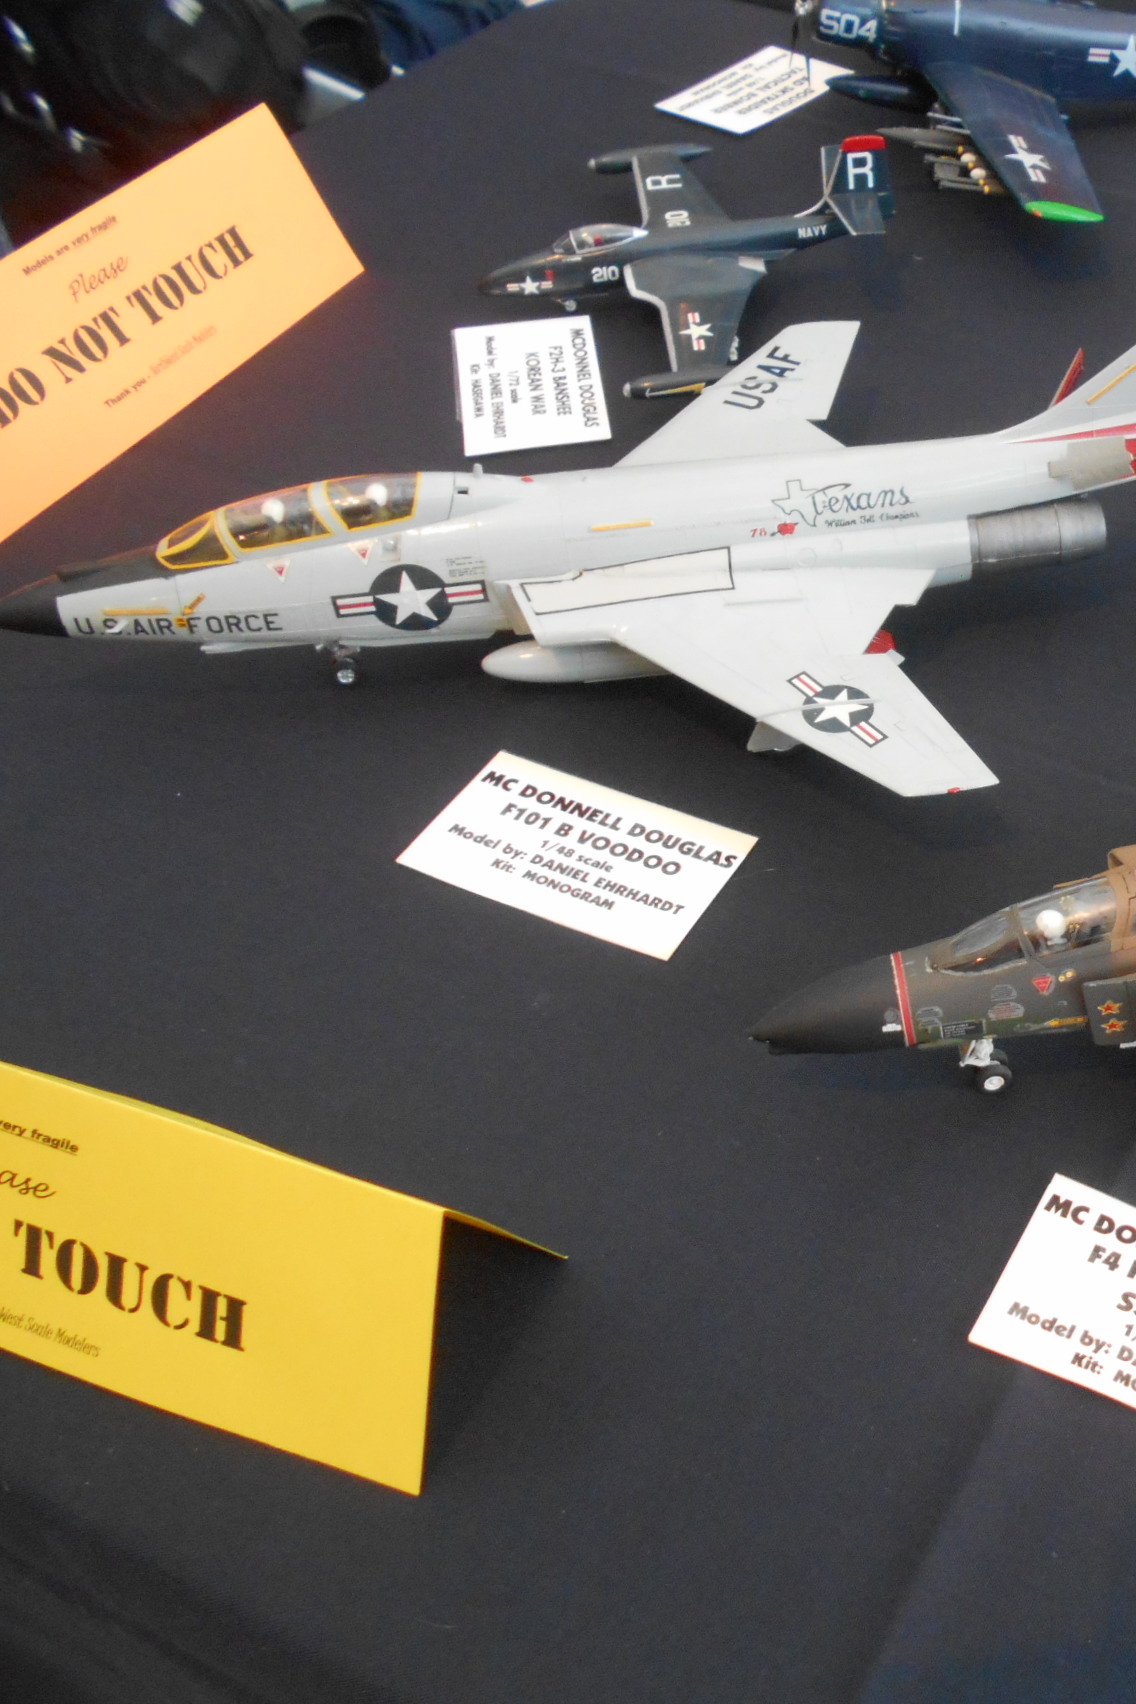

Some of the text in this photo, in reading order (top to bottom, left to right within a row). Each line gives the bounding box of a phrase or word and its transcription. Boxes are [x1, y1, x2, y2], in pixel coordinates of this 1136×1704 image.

[820, 8, 877, 42] 504
[646, 174, 682, 190] R
[847, 151, 874, 190] R
[798, 225, 827, 239] NAVY
[22, 254, 55, 276] Models
[55, 244, 70, 257] are
[592, 265, 620, 283] 210
[69, 256, 128, 303] Please
[41, 306, 131, 384] NOT
[125, 225, 254, 326] TOUCH
[524, 351, 546, 415] KOREAN WAR
[552, 375, 572, 416] BANSHEE
[723, 346, 801, 410] USAF
[578, 384, 599, 427] DOUGLAS
[807, 483, 912, 515] Texans
[132, 617, 175, 635] AIR
[186, 613, 283, 635] FORCE
[481, 771, 737, 869] MC DONNELL DOUGLAS
[500, 803, 682, 876] F101 B VOODOO
[539, 839, 614, 872] 1/48 scale
[448, 824, 684, 915] Model by: DANIEL EHRHARDT
[490, 858, 615, 910] Kit: MONOGRAM
[31, 1129, 80, 1153] fragile
[1043, 1194, 1090, 1225] MC
[1088, 1245, 1120, 1271] F4
[14, 1218, 247, 1352] TOUCH
[54, 1328, 101, 1357] Modelers
[1007, 1301, 1076, 1339] Model
[1079, 1330, 1111, 1356] by:
[1071, 1352, 1103, 1375] Kit:
